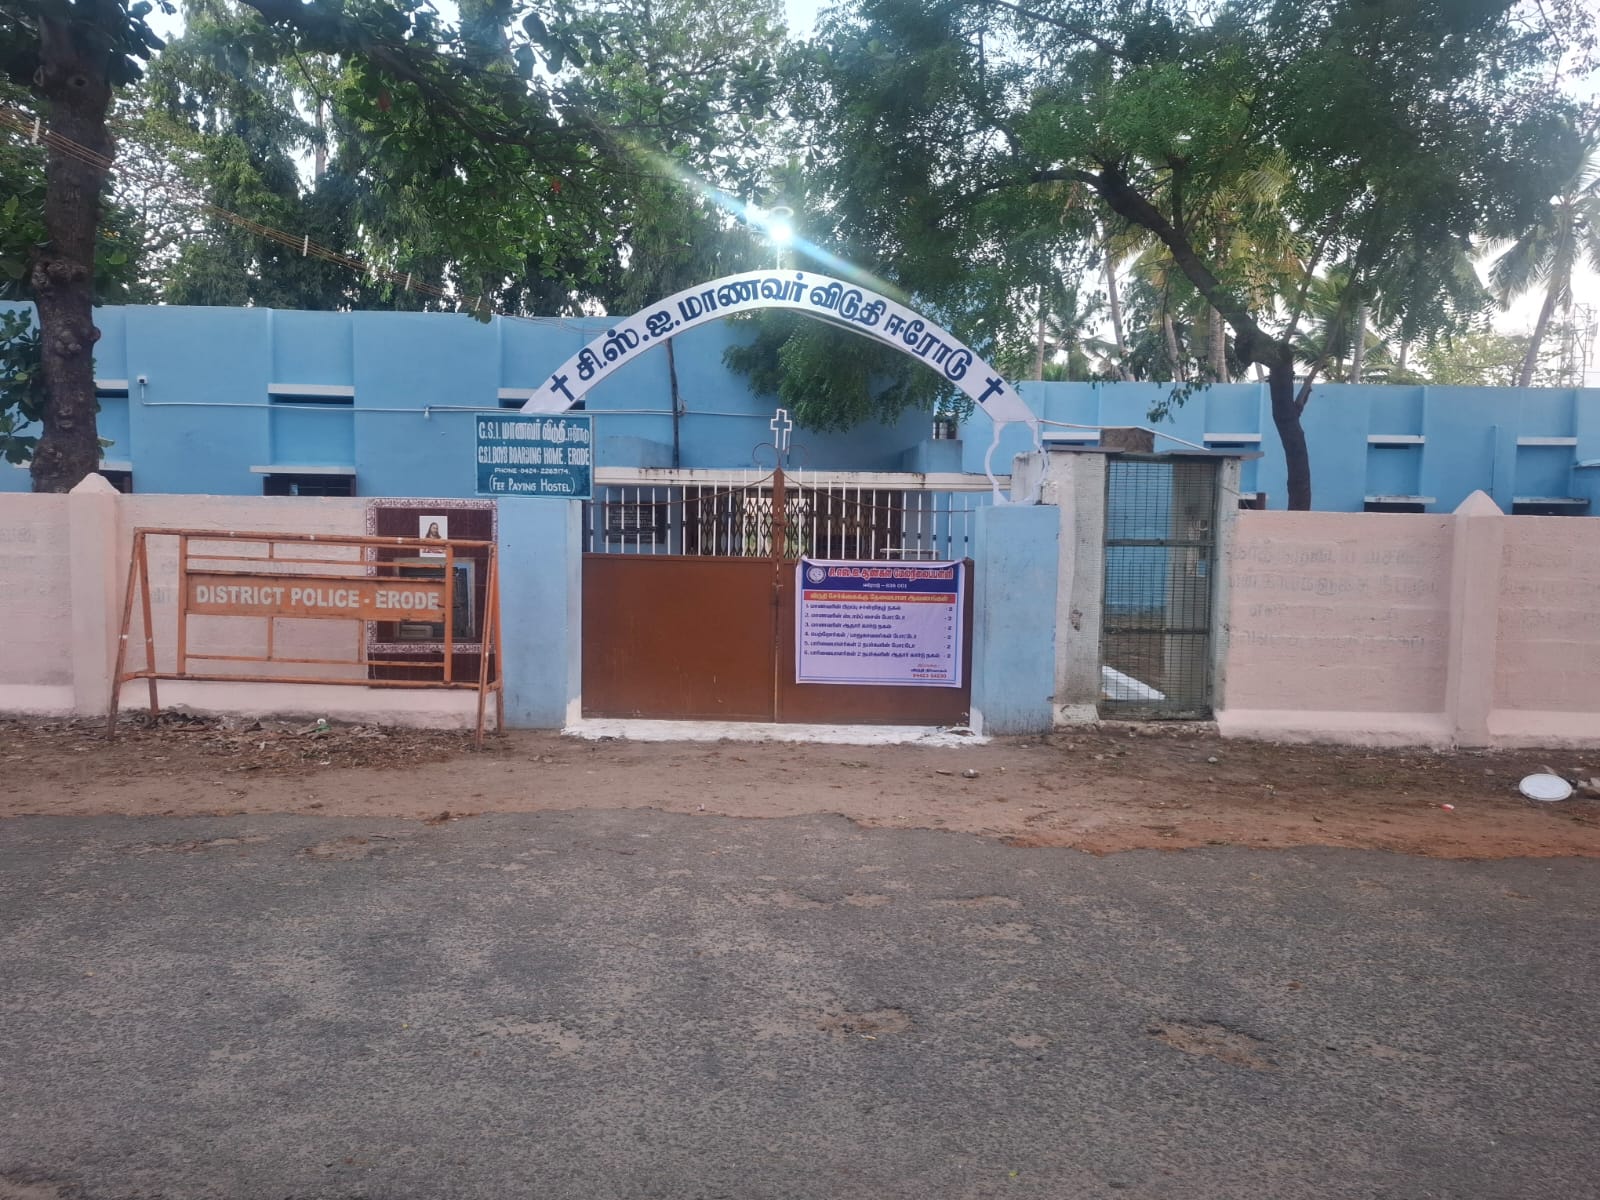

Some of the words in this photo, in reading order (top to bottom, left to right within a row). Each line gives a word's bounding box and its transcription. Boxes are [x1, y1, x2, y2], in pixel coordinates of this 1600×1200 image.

[809, 282, 887, 327] விடுதி
[883, 312, 973, 382] ஈரோடு
[501, 418, 541, 441] மாணவர்
[508, 446, 542, 465] BOARDING
[567, 447, 590, 466] ERODE
[196, 585, 285, 606] DISTRICT
[290, 588, 361, 608] POLICE
[375, 591, 440, 610] ERODE
